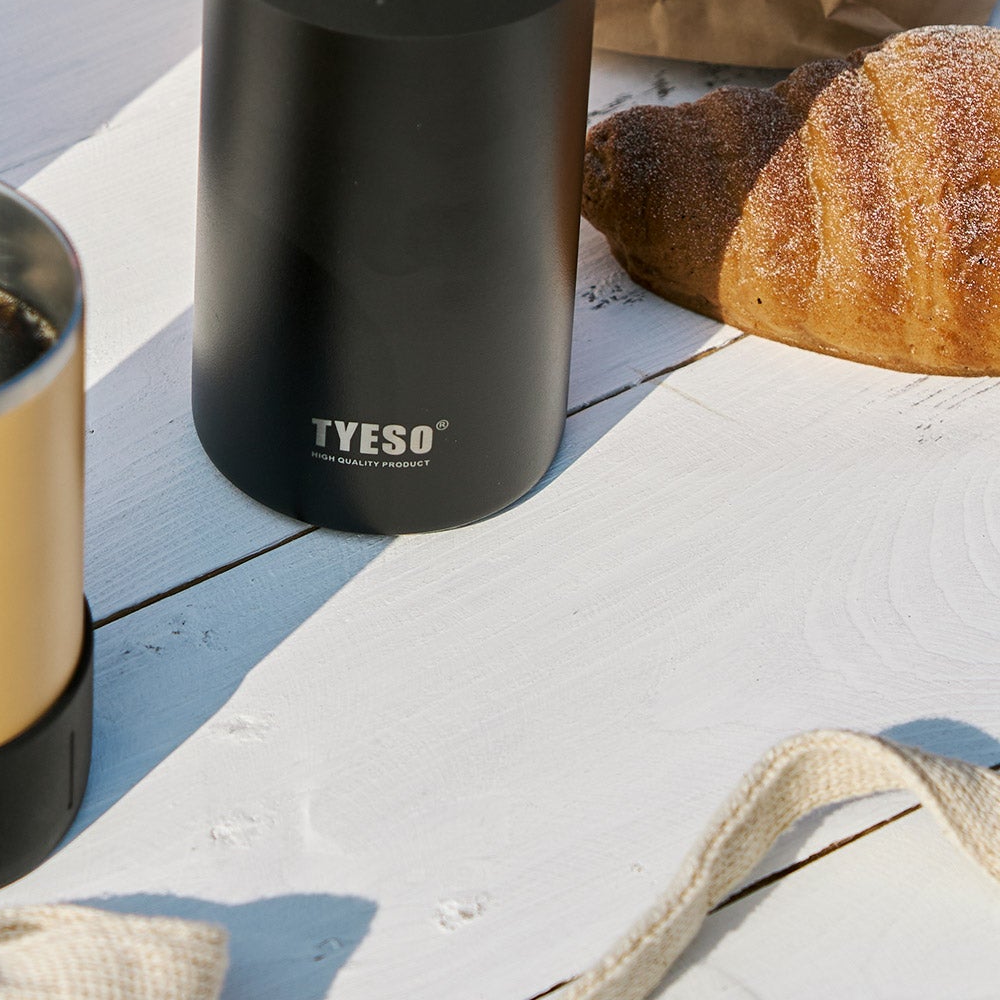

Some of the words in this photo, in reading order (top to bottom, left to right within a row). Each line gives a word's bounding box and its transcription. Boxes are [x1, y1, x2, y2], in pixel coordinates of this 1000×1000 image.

[311, 451, 336, 462] HIGH
[337, 456, 380, 468] QUALITY
[381, 459, 431, 469] PRODUCT
